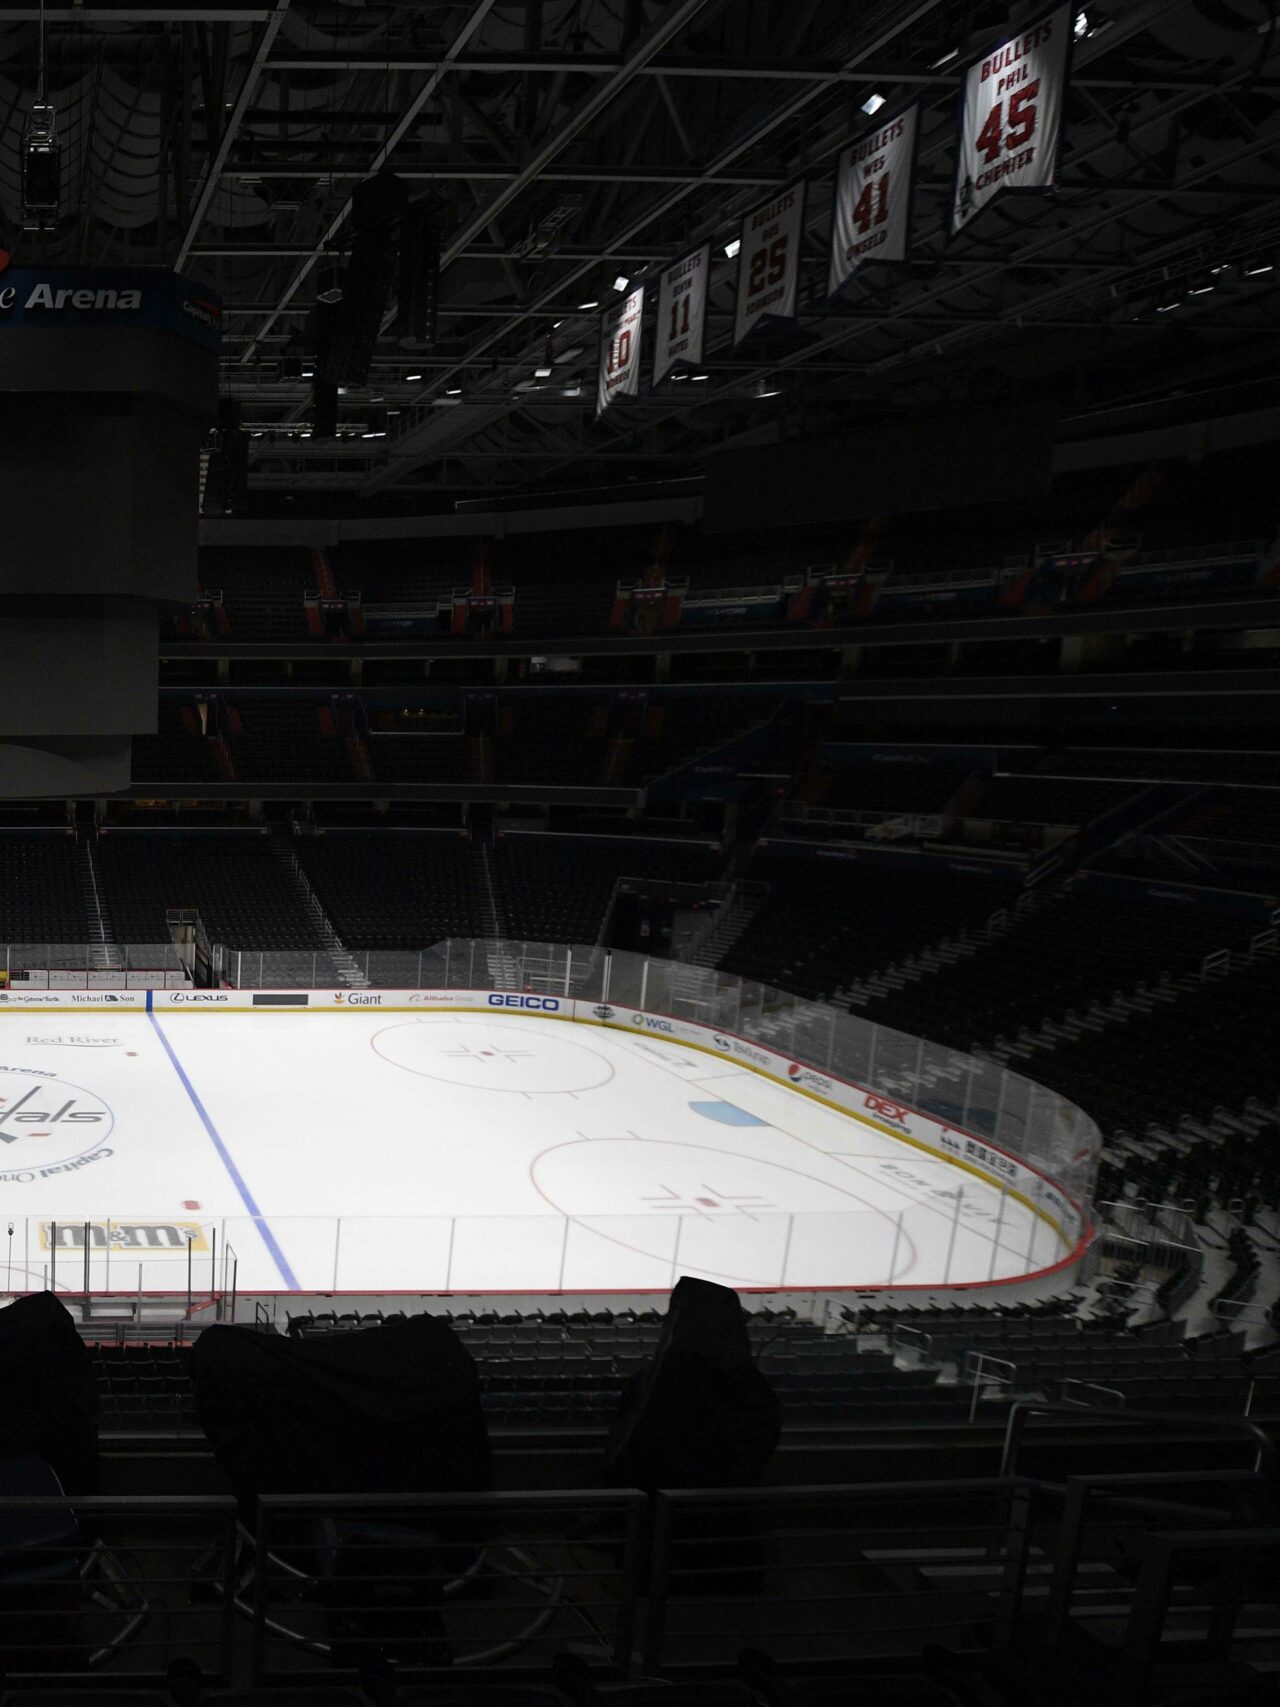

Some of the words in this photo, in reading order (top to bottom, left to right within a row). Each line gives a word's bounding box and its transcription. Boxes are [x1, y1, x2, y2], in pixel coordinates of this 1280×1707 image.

[981, 18, 1053, 83] BULLETS
[998, 64, 1029, 96] PHIL
[976, 78, 1040, 165] 45
[850, 118, 905, 169] BULLETS
[976, 147, 1034, 190] CHENIER
[852, 171, 890, 235] 41
[749, 235, 788, 298] 25
[24, 283, 142, 310] Arena
[669, 294, 690, 341] 11
[607, 330, 631, 375] 10
[72, 994, 104, 1002] Michael
[120, 994, 136, 1002] Son
[186, 994, 229, 1002] LEXUS
[348, 993, 382, 1005] Giant
[488, 994, 559, 1011] GEICO
[26, 1035, 64, 1044] Red
[69, 1035, 122, 1044] River
[646, 1018, 675, 1034] WGL
[864, 1095, 911, 1124] DEX
